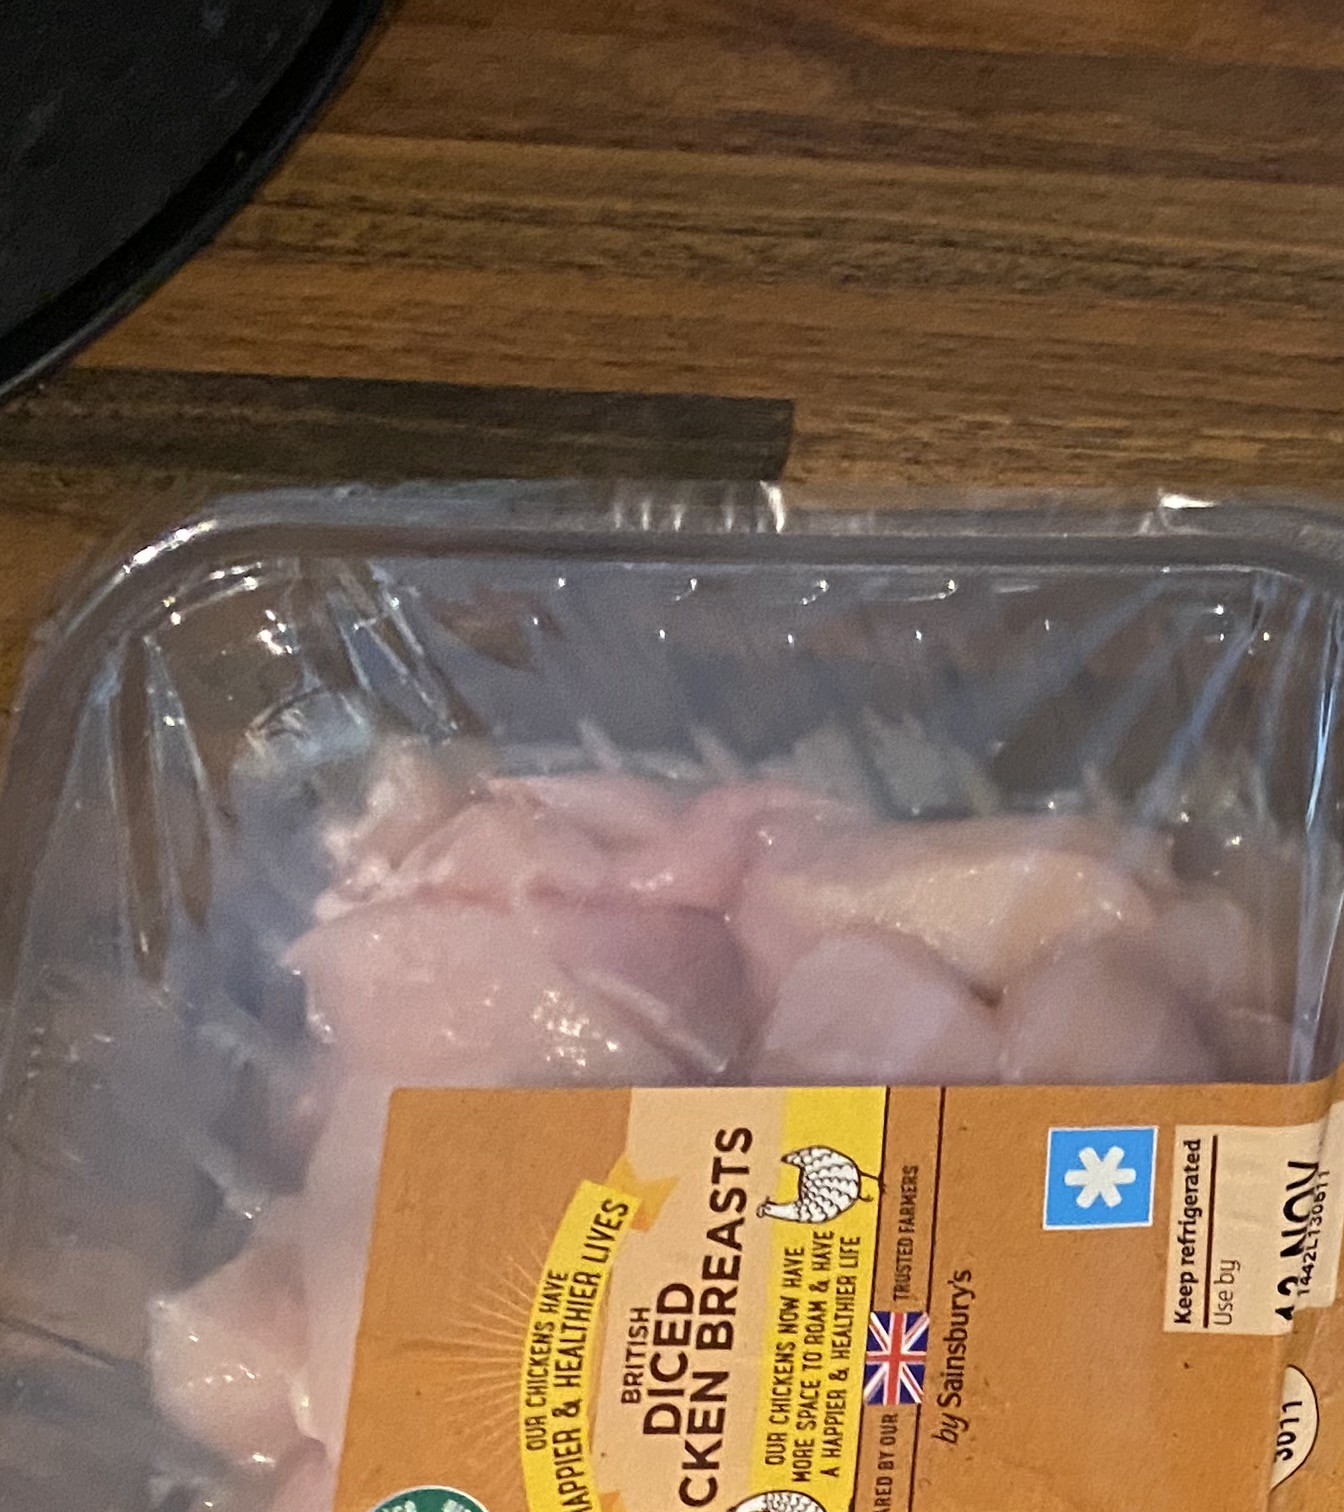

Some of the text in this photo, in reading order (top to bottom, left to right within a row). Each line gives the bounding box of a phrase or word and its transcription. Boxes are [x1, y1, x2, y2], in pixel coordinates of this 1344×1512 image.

[581, 1197, 630, 1268] LIVES
[695, 1126, 754, 1351] BREASTS
[899, 1164, 920, 1232] FARMERS
[1174, 1138, 1203, 1325] Keep refrigerated
[893, 1236, 916, 1302] TRUSTED
[1213, 1259, 1241, 1326] Use by
[525, 1269, 569, 1452] OUR CHICKENS HAVE
[553, 1270, 601, 1389] HEALTHIER
[620, 1306, 652, 1405] BRITISH
[642, 1282, 695, 1435] DICED
[765, 1246, 805, 1466] OUR CHICKENS NOW HAVE
[792, 1230, 834, 1482] MORE SPACE TO ROAM & HAVE
[820, 1236, 860, 1478] A HAPPIER & HEALTHIER LIFE
[931, 1268, 976, 1446] by Sainsbury's
[552, 1399, 582, 1420] &
[878, 1449, 895, 1472] BY
[884, 1412, 898, 1445] OUR
